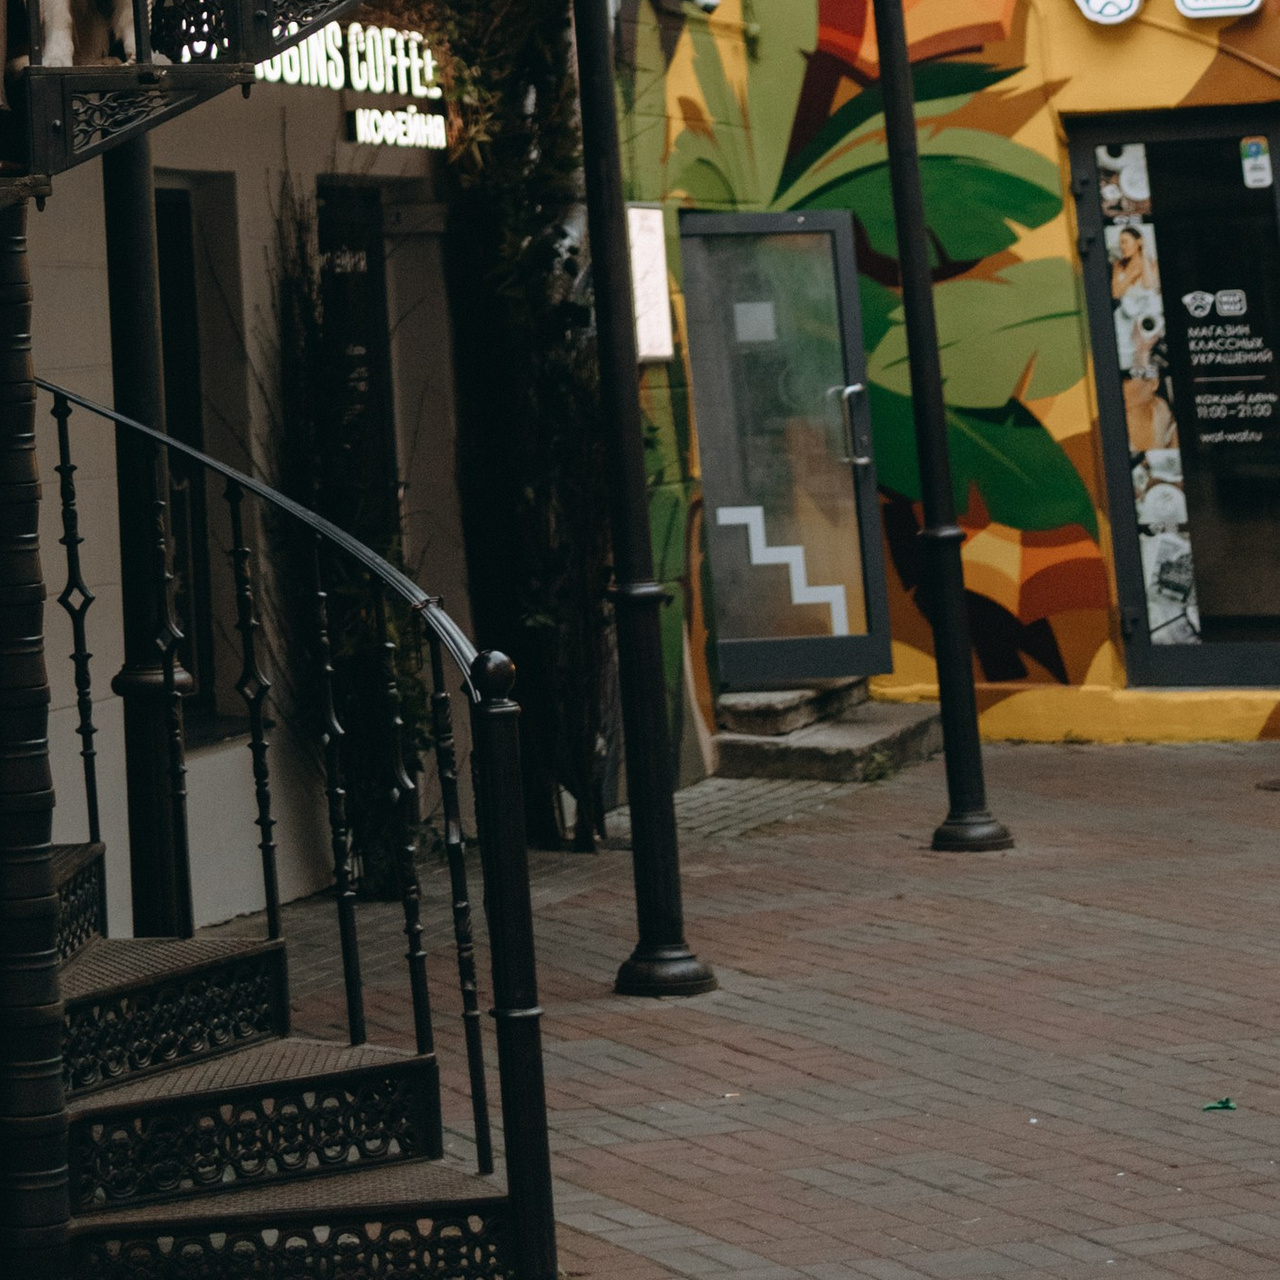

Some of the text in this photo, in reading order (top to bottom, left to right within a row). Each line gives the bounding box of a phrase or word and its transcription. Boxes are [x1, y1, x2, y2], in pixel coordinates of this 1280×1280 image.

[348, 22, 442, 99] COFFEE
[356, 105, 447, 149] КОФЕЙНЯ
[1187, 324, 1251, 338] МАГАЗИН
[1188, 336, 1264, 351] КЛАССНЫХ
[1190, 348, 1273, 366] УКРАШЕНИЙ
